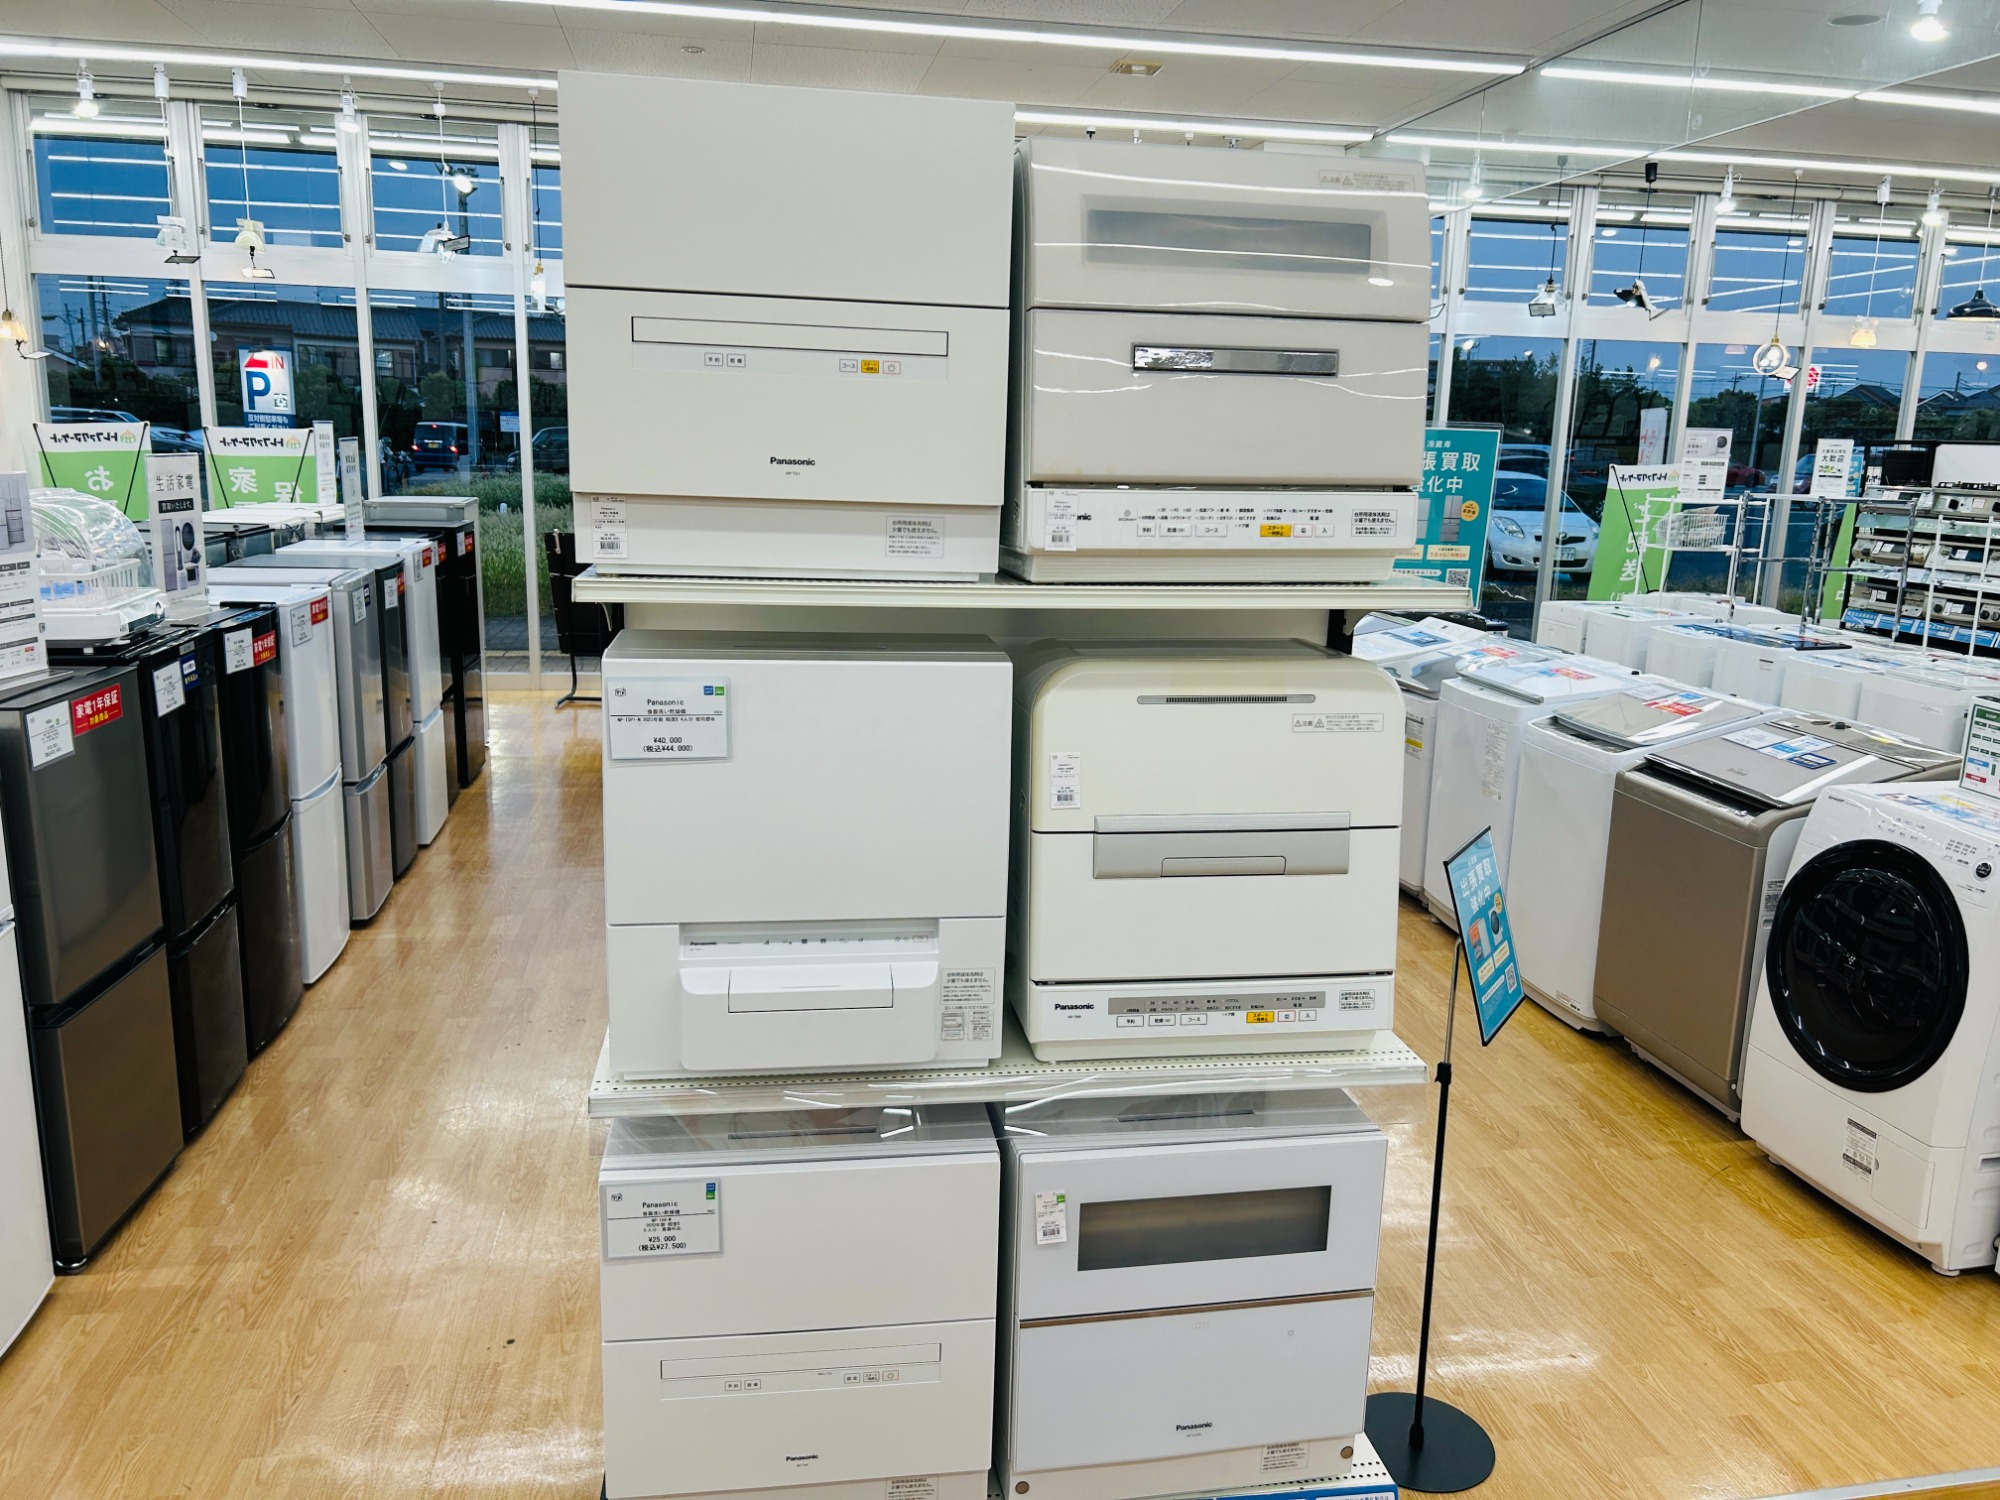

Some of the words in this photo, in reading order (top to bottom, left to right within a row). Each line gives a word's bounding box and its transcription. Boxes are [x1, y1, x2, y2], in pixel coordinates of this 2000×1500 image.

[271, 356, 285, 369] IN
[246, 371, 271, 410] P
[1427, 439, 1452, 448] 冷蔵庫
[769, 456, 816, 466] Panasonic
[1821, 455, 1845, 463] 大歓迎
[156, 474, 194, 492] 生活家電
[75, 689, 118, 719] 家電1年保証
[653, 737, 682, 745] ¥40,000
[1459, 857, 1493, 898] 出張買取
[1054, 1003, 1095, 1011] Panasonic
[642, 1201, 678, 1209] Panasonic
[648, 1235, 677, 1243] ¥25,000
[1176, 1421, 1213, 1432] Panasonic
[786, 1453, 819, 1462] Panasonic
